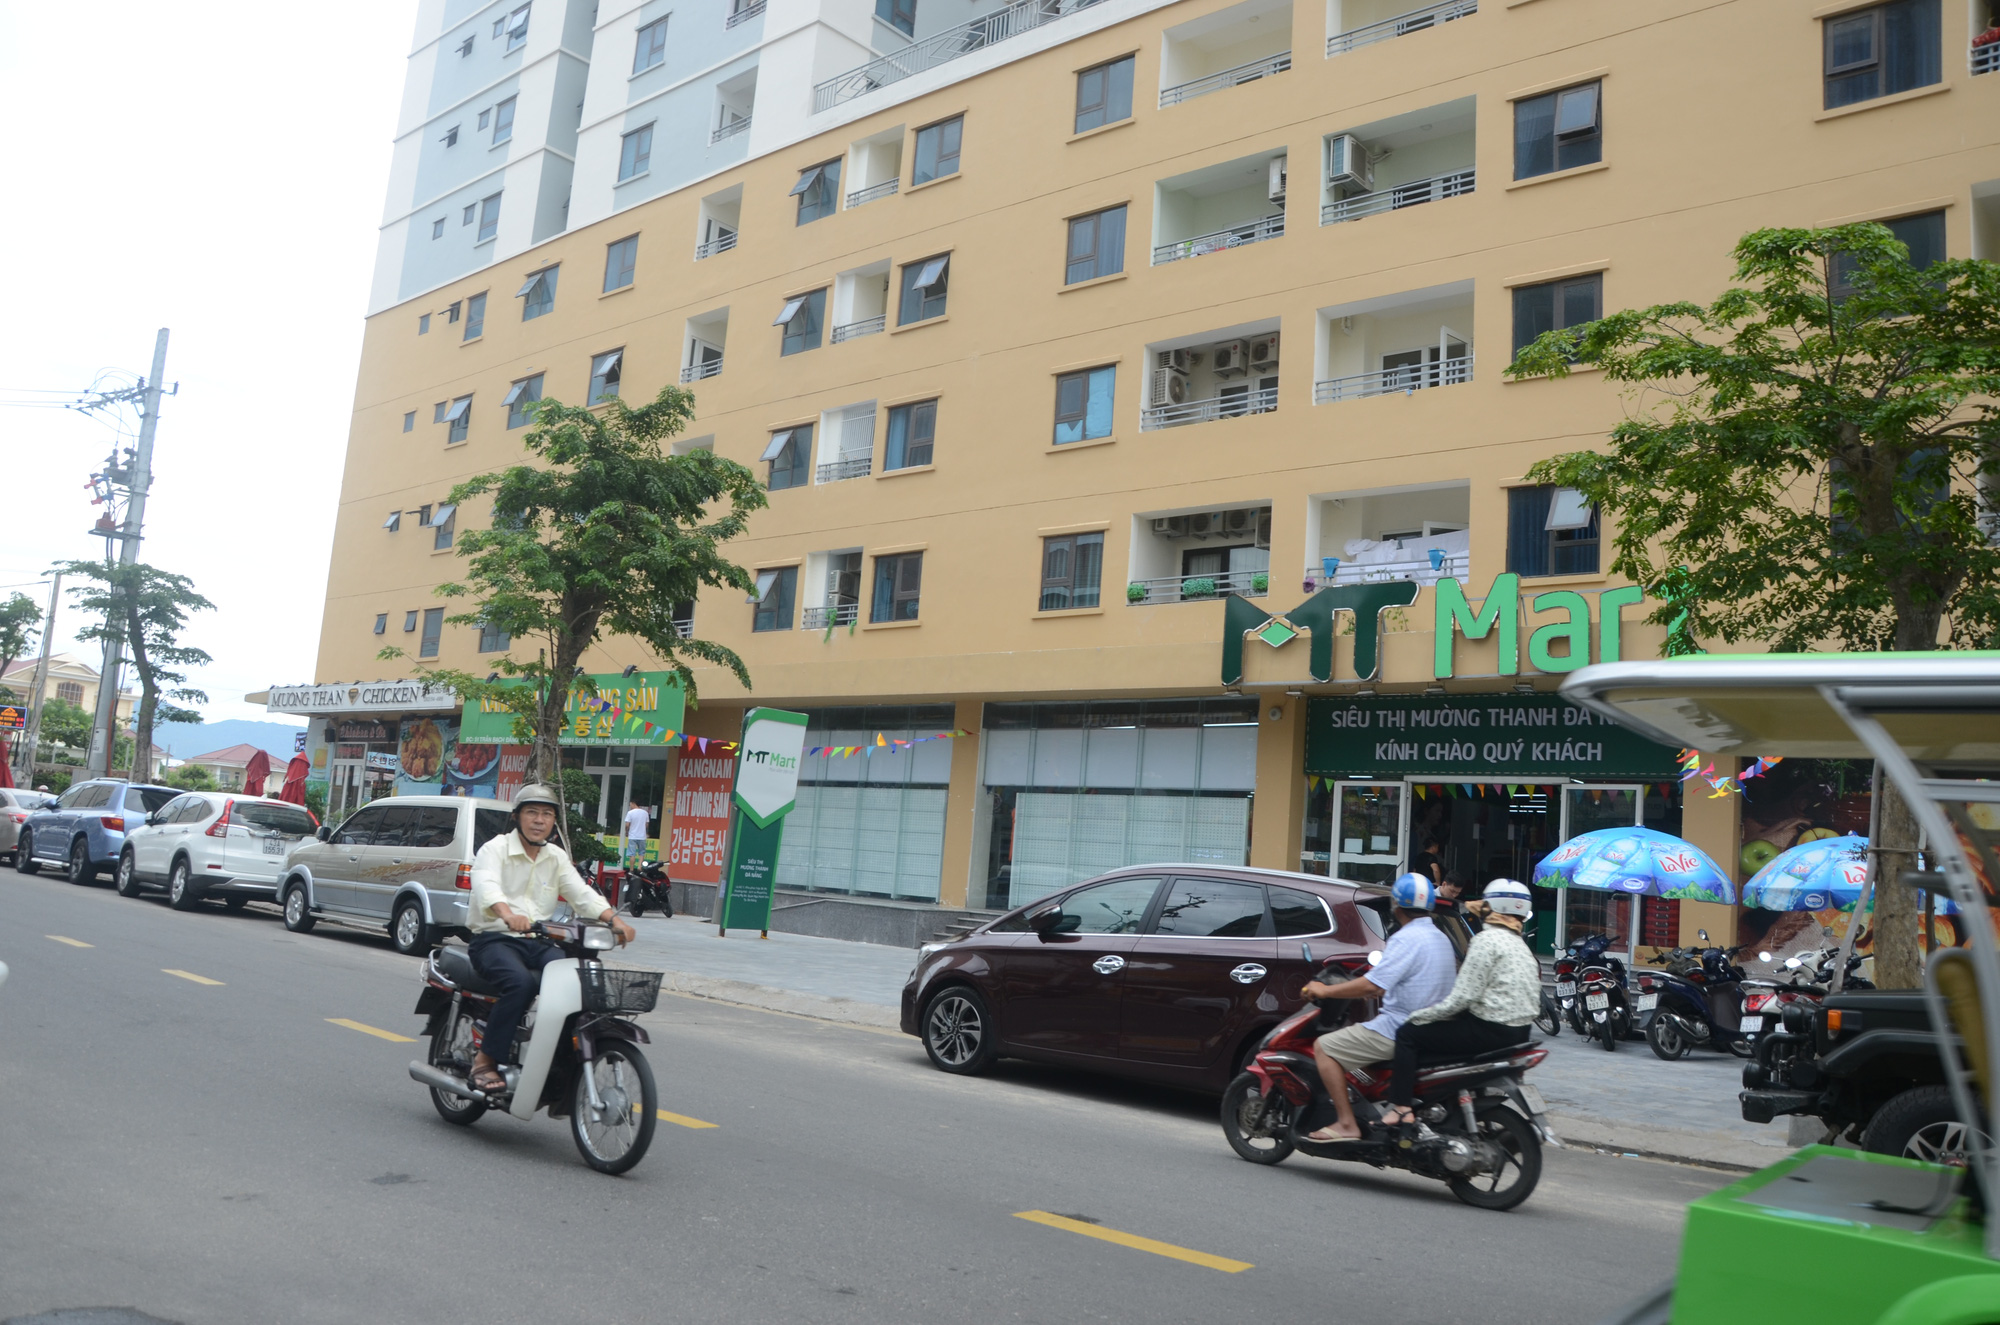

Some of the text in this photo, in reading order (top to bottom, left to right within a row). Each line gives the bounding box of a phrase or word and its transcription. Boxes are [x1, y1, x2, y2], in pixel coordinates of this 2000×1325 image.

[1222, 581, 1420, 686] MT
[271, 691, 310, 707] MUONG
[362, 686, 420, 704] CHICKEN
[624, 677, 659, 713] SẢN
[1331, 704, 1371, 728] SIÊU
[1375, 709, 1406, 732] THỊ
[1410, 703, 1481, 728] MƯỜNG
[1487, 707, 1558, 727] THANH
[769, 753, 796, 769] Mart
[1375, 737, 1602, 763] KÍNH CHÀO QUÝ KHÁCH
[679, 758, 733, 779] KANGNAM
[675, 783, 730, 823] BẤT ĐỘNG SẢN
[671, 826, 727, 867] 강남부동산
